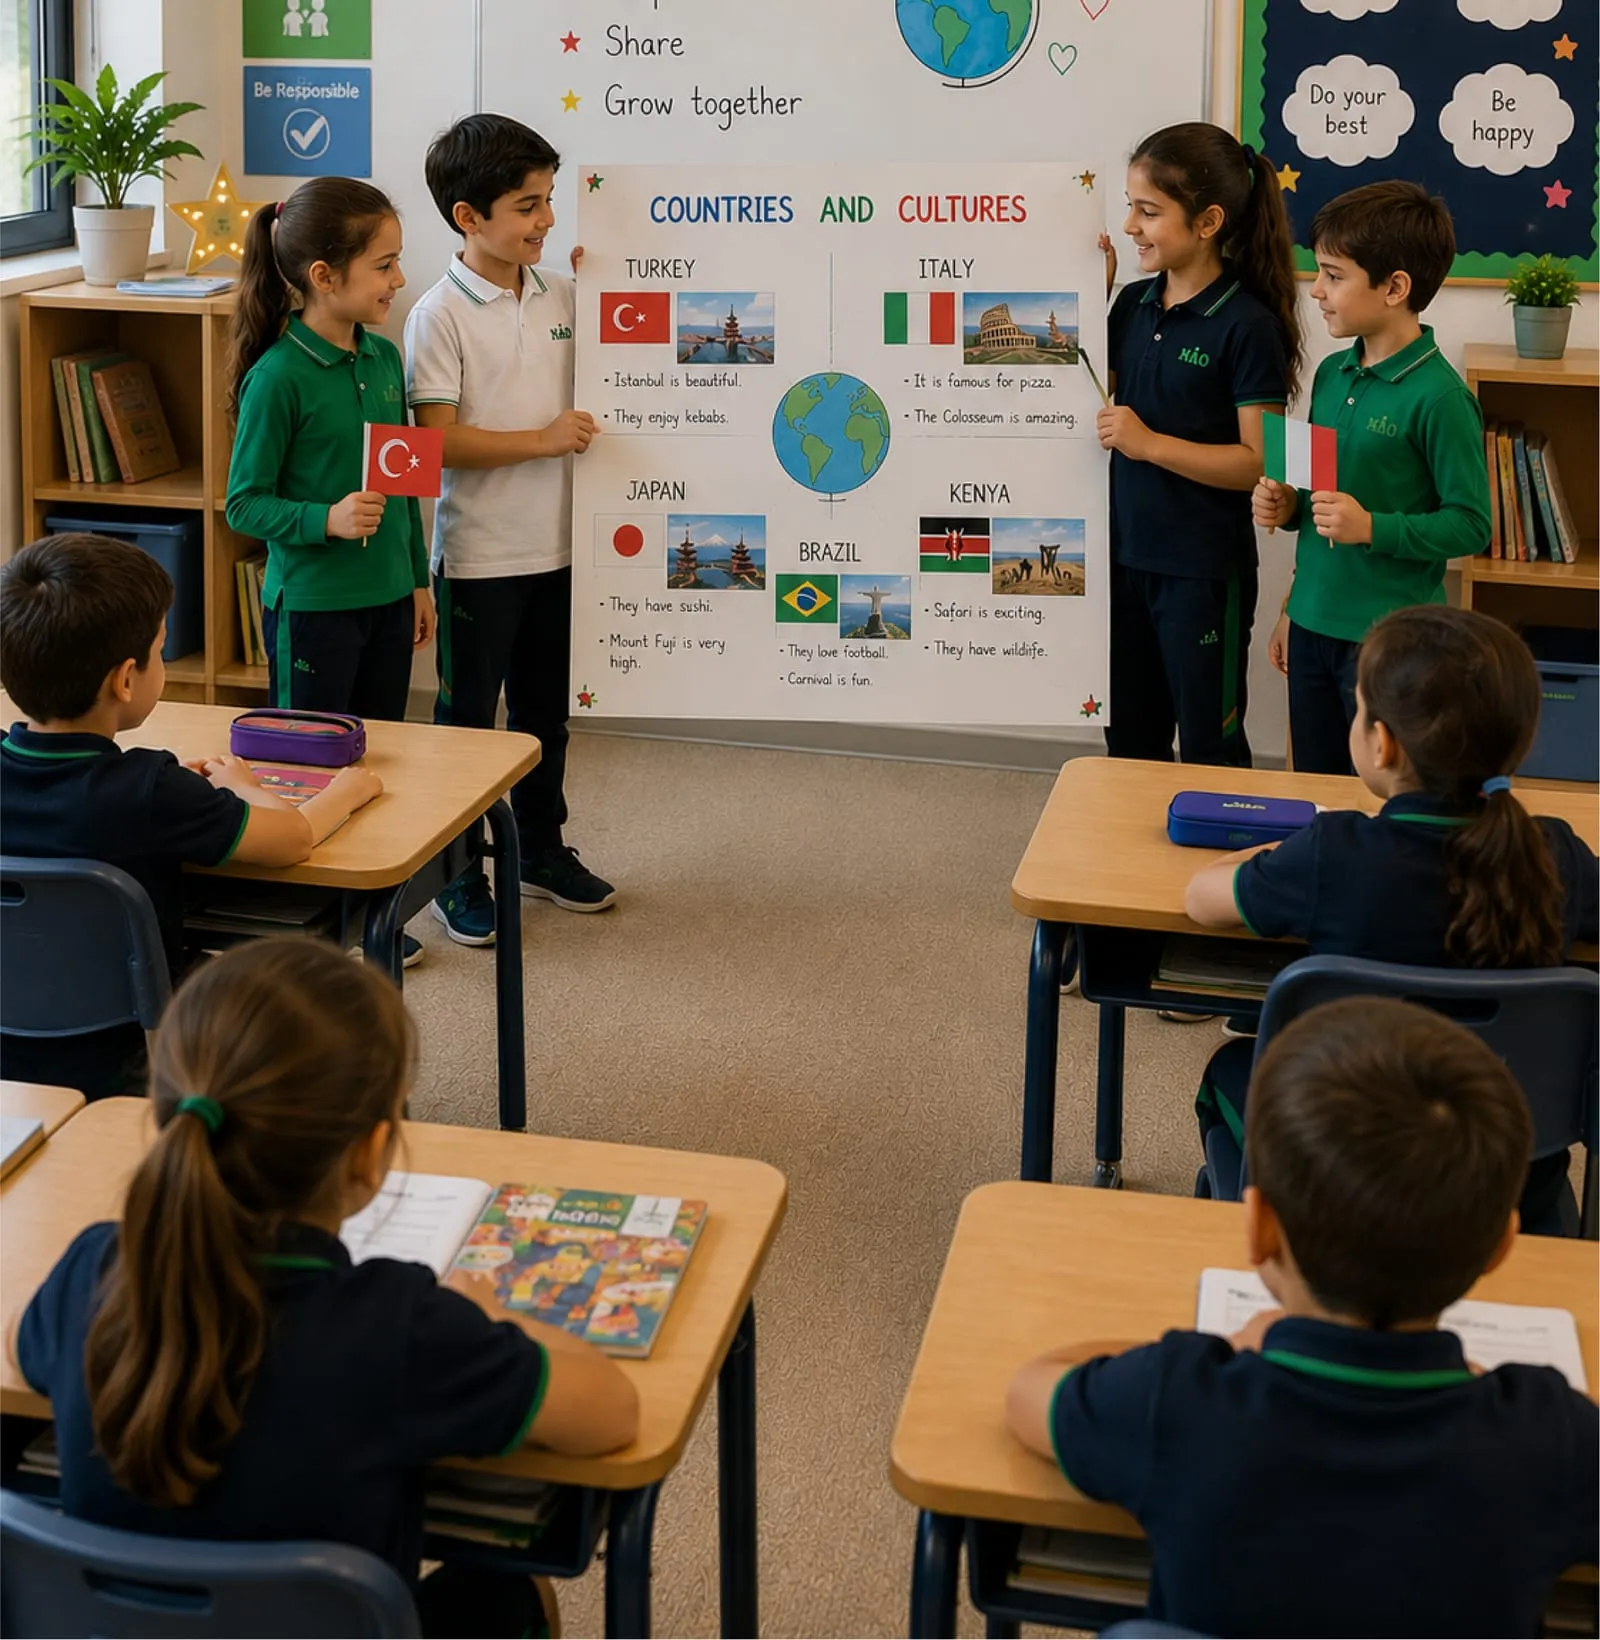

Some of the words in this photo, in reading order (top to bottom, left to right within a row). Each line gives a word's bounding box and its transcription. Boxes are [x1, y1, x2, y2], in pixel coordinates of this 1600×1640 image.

[605, 24, 685, 57] Share
[253, 81, 274, 99] Be
[1310, 83, 1336, 105] Do
[1343, 90, 1387, 112] your
[1491, 89, 1517, 113] Be
[605, 83, 674, 116] Grow
[690, 85, 803, 132] together
[1325, 113, 1368, 135] best
[1472, 119, 1535, 150] happy
[650, 195, 794, 224] COUNTRIES
[819, 195, 874, 224] AND
[898, 194, 1027, 223] CULTURES
[624, 258, 696, 279] TURKEY
[918, 258, 975, 279] ITALY
[614, 371, 665, 388] Istanbul
[670, 375, 680, 388] is
[685, 371, 742, 388] beautiful.
[914, 372, 927, 389] It
[932, 376, 942, 389] is
[947, 372, 991, 389] famous
[996, 372, 1014, 388] for
[1019, 375, 1056, 393] pizza.
[613, 408, 643, 430] They
[647, 411, 680, 430] enjoy
[685, 408, 729, 424] kebabs.
[913, 408, 938, 424] The
[942, 408, 1004, 424] Colosseum
[1009, 411, 1021, 424] is
[1025, 411, 1078, 430] amazing.
[626, 480, 686, 501] JAPAN
[950, 482, 1011, 504] KENYA
[799, 541, 862, 563] BRAZIL
[609, 595, 639, 617] They
[645, 597, 673, 613] have
[679, 598, 713, 613] sushi.
[933, 601, 972, 623] Safari
[978, 606, 988, 619] is
[994, 605, 1046, 626] exciting.
[609, 633, 649, 648] Mount
[655, 633, 677, 656] Fuji
[682, 636, 693, 650] is
[698, 639, 726, 656] very
[787, 643, 814, 663] They
[817, 644, 838, 658] love
[843, 644, 889, 659] football.
[933, 639, 964, 661] They
[968, 640, 997, 656] have
[609, 654, 641, 675] high.
[787, 671, 833, 686] Carnival
[837, 674, 847, 686] is
[851, 672, 874, 687] fun.
